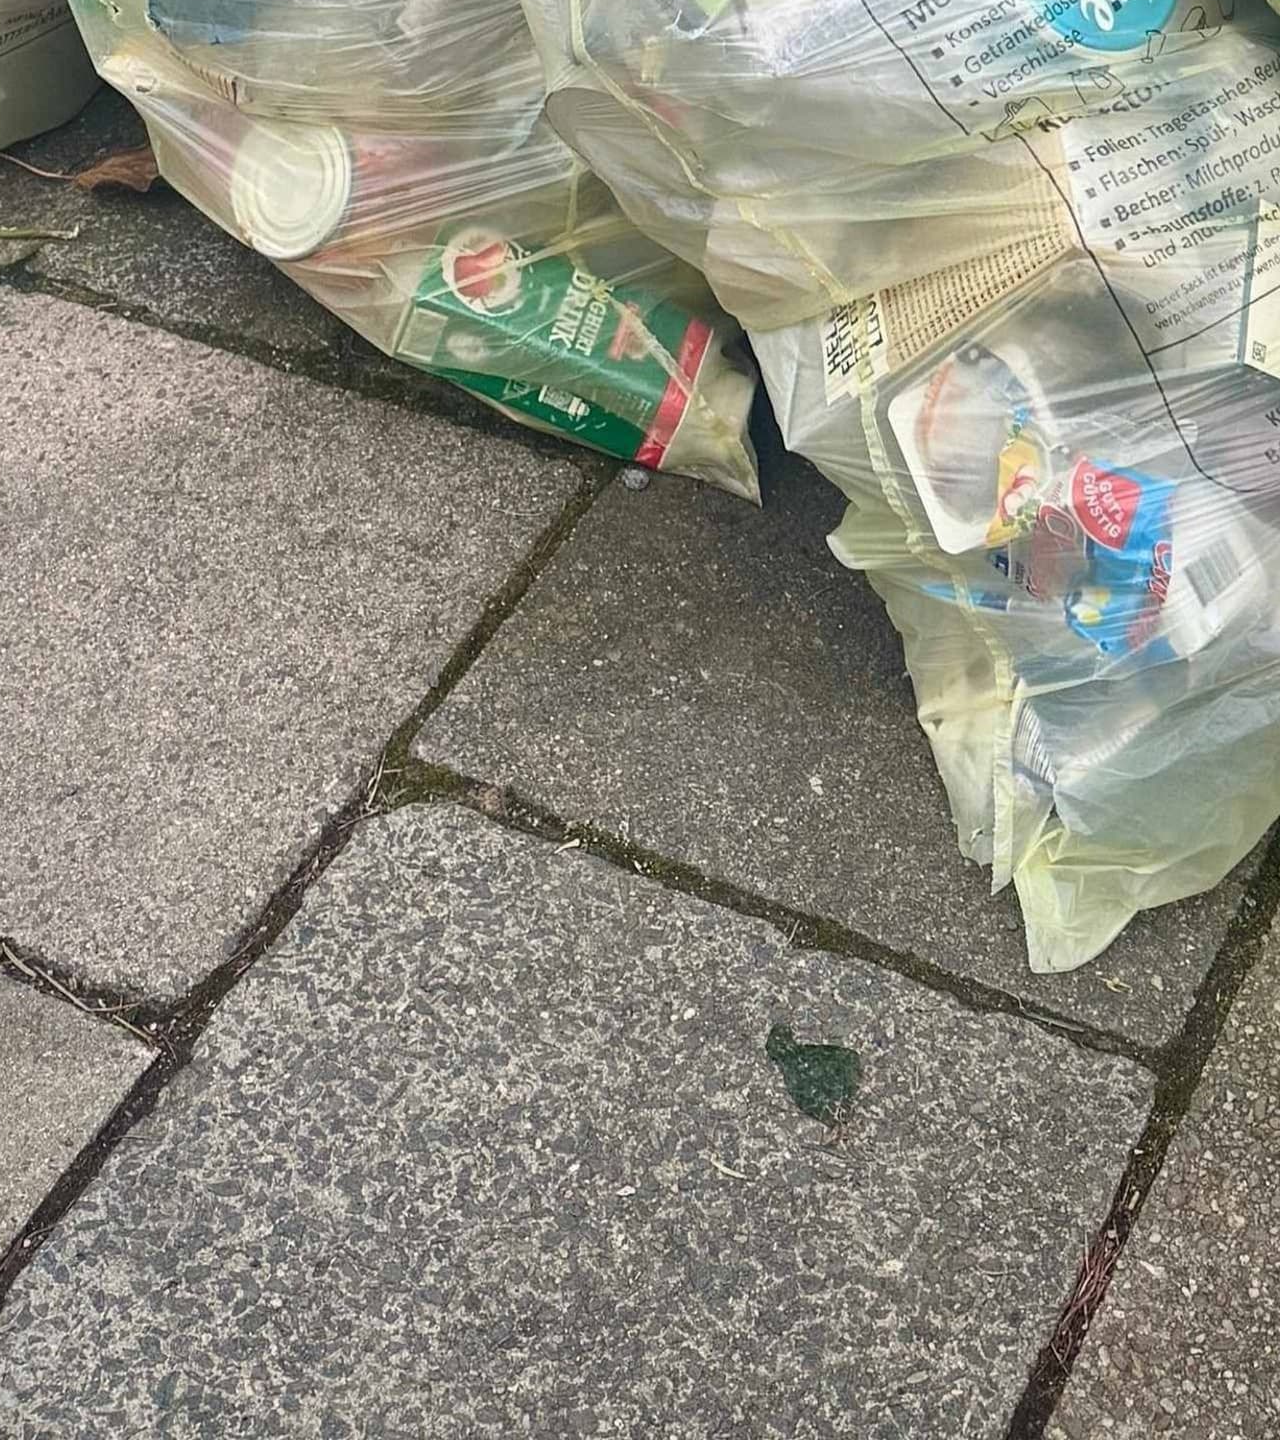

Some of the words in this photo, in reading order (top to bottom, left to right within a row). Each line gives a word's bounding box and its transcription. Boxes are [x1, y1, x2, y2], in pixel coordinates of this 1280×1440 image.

[981, 27, 1085, 100] Verschlüsse
[1084, 128, 1145, 163] Folien:
[1099, 142, 1188, 193] Flaschen:
[1115, 178, 1187, 224] Becher:
[1142, 240, 1178, 270] und
[548, 269, 596, 349] DRINK
[1082, 471, 1122, 540] GÜNSTIG
